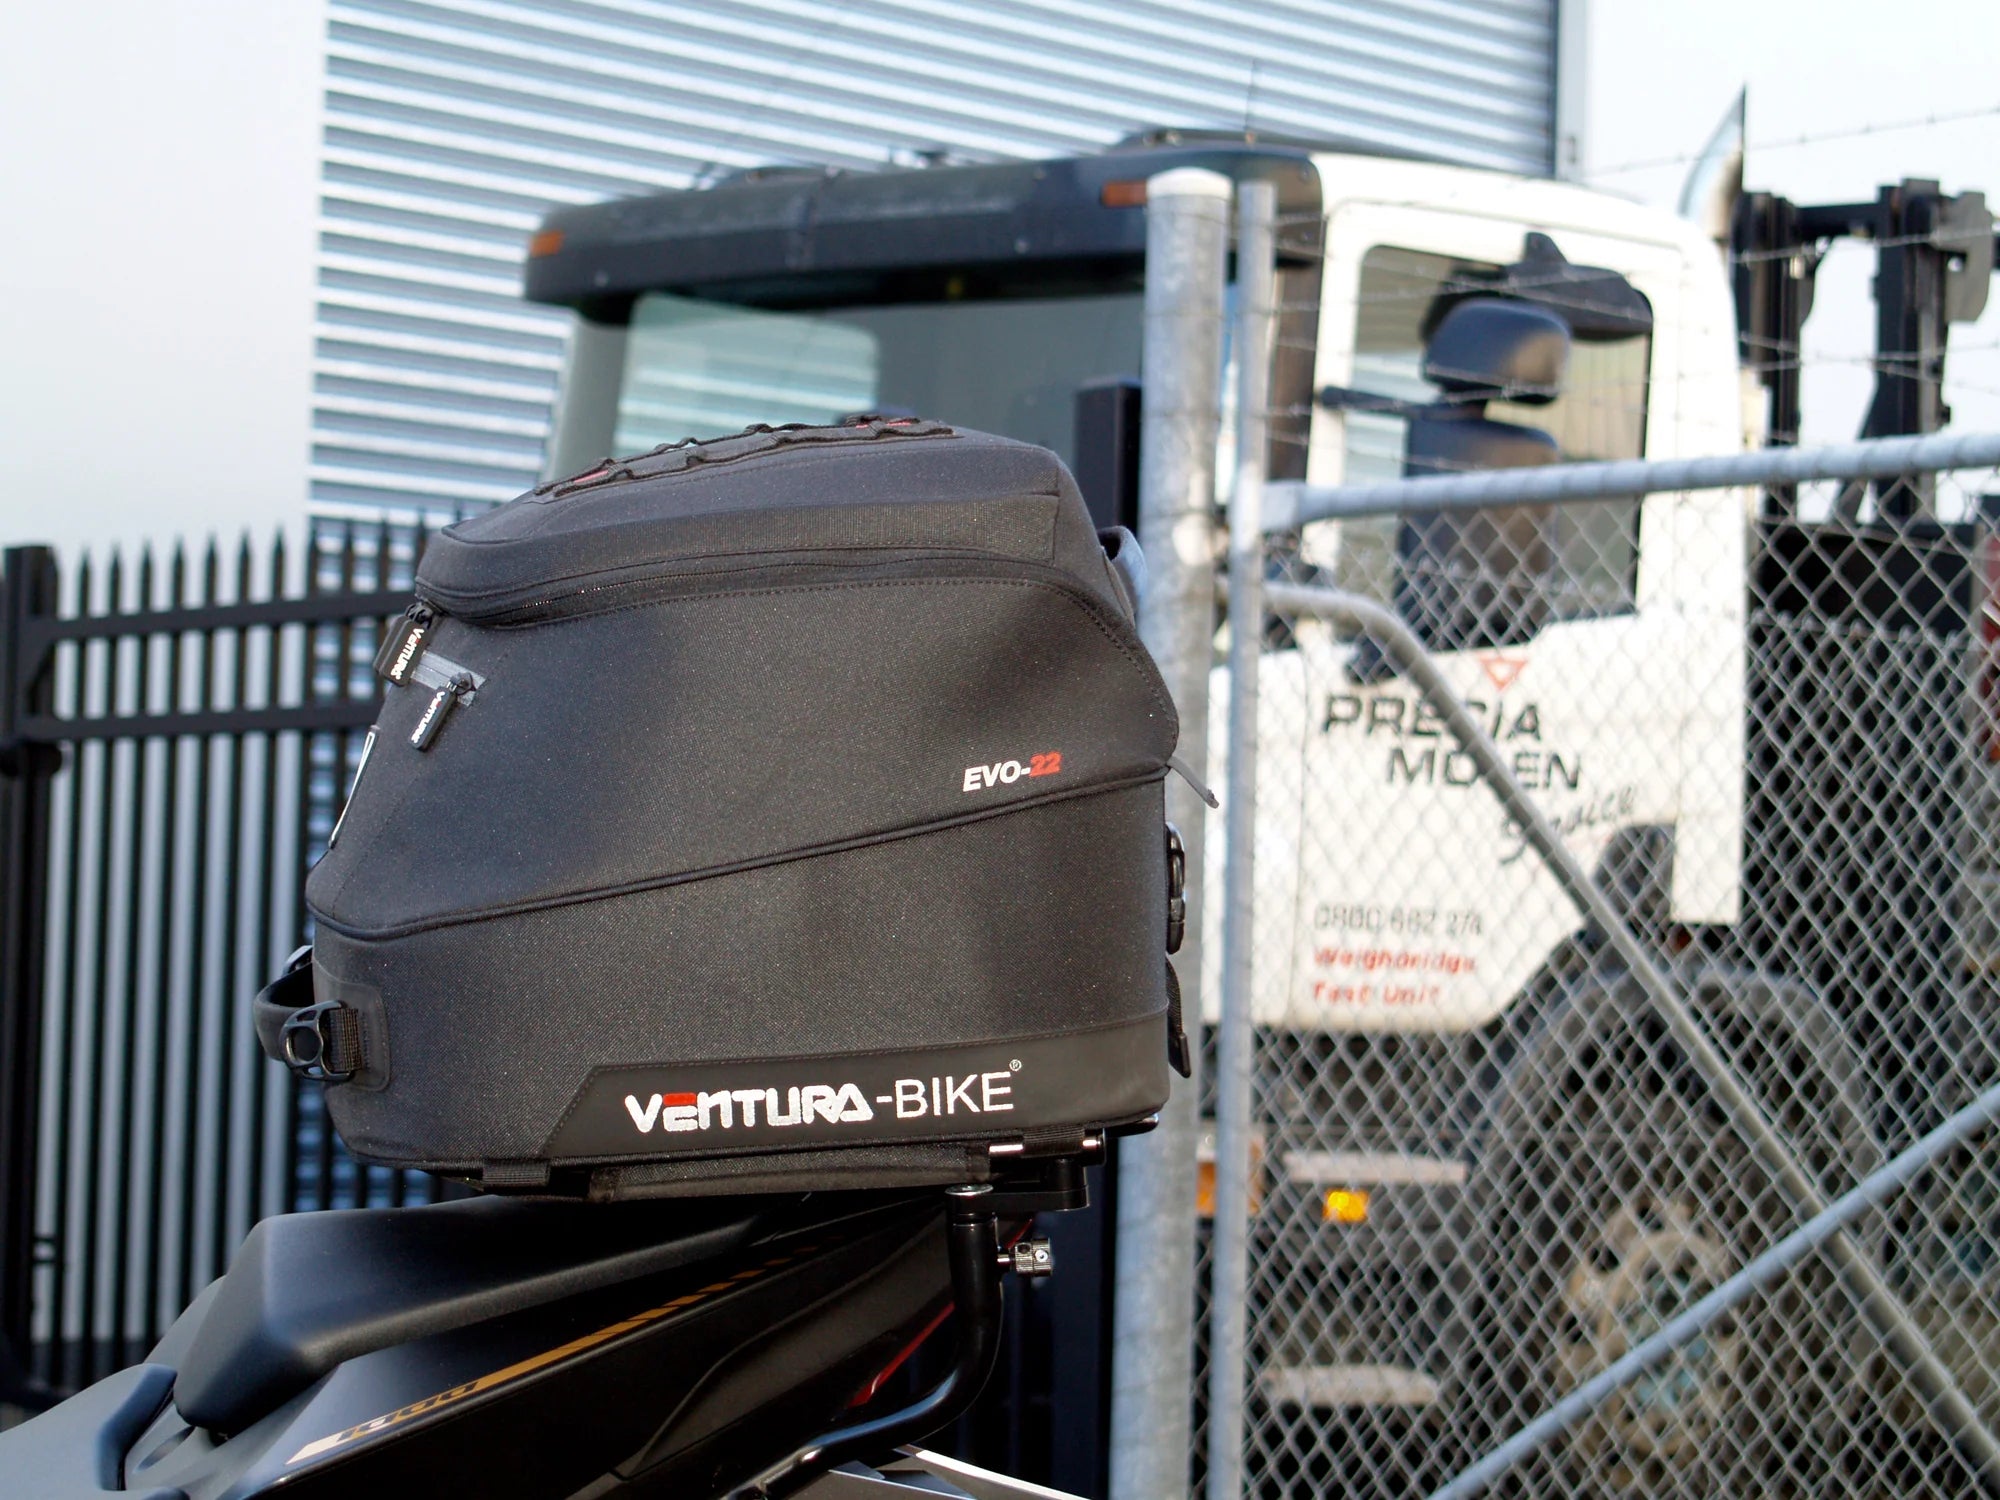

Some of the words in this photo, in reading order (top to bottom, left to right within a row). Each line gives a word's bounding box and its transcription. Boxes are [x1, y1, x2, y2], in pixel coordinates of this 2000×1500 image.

[390, 627, 425, 680] VENTURA
[962, 751, 1062, 792] EVO-22
[1387, 748, 1581, 790] MOEN
